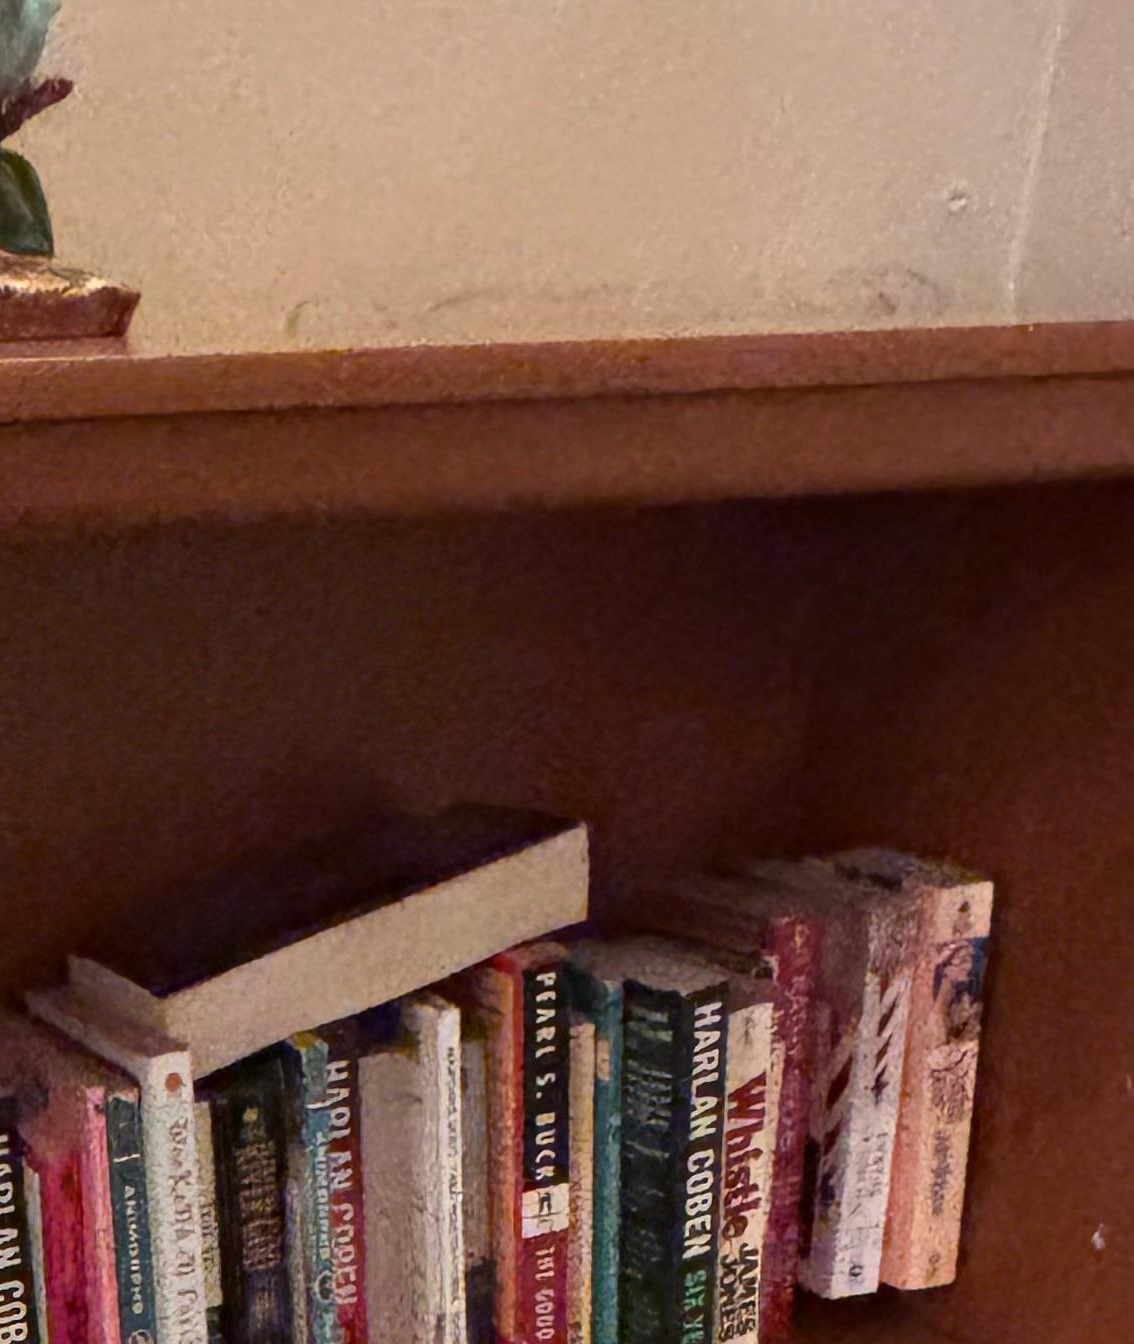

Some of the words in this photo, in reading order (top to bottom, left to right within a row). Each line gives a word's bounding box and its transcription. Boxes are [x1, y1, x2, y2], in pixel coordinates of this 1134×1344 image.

[535, 971, 556, 1058] PEARL
[535, 1073, 556, 1099] S.
[690, 1001, 722, 1141] HARLAN
[535, 1112, 556, 1180] BUCK
[722, 1071, 766, 1240] Whistle
[683, 1149, 714, 1259] COBEN
[535, 1246, 556, 1281] THE
[683, 1269, 707, 1311] SIX
[720, 1254, 738, 1344] JONES
[735, 1242, 760, 1336] JAMES
